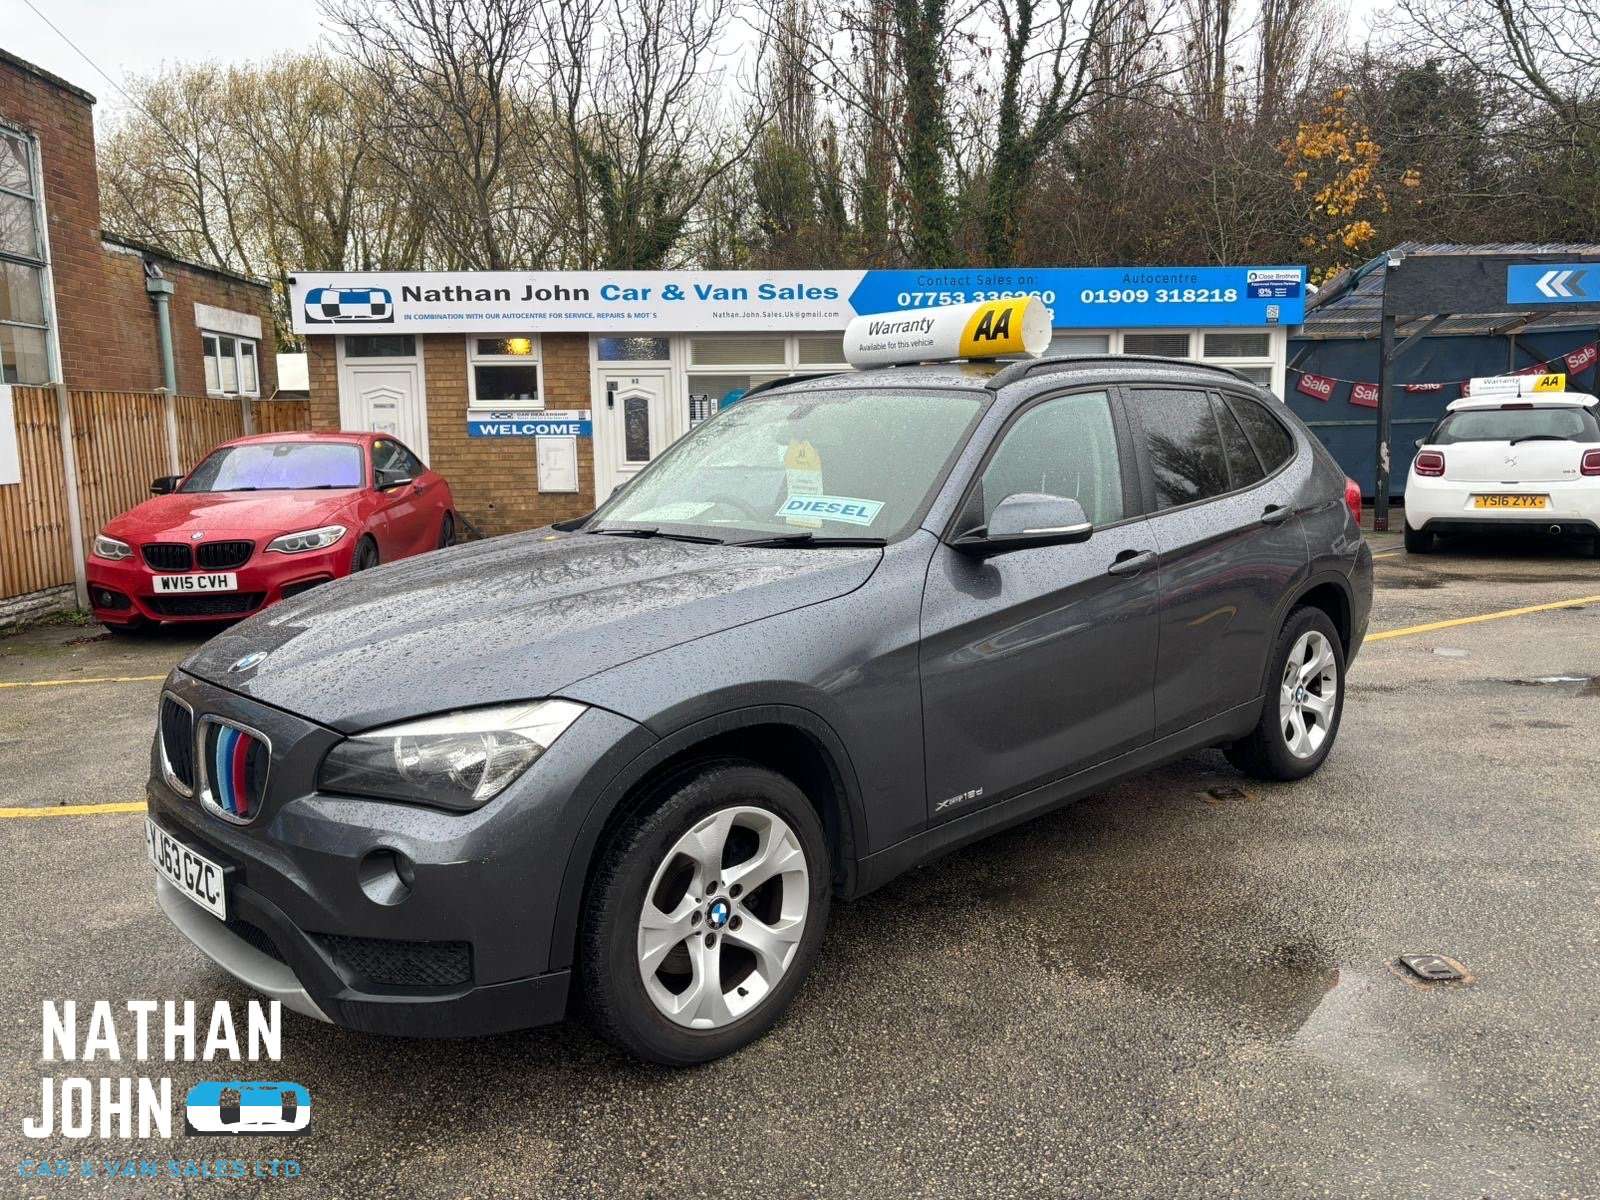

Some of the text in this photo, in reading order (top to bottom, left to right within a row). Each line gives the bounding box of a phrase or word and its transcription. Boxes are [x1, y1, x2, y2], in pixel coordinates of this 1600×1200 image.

[918, 274, 1039, 286] Contact Sales on:
[1123, 272, 1198, 284] Autocentre
[401, 283, 839, 302] Nathan John Car & Van Sales
[897, 291, 965, 306] 07753
[1080, 288, 1238, 303] 01909 318218
[403, 313, 412, 321] IN
[413, 313, 464, 321] COMBINATION
[485, 312, 501, 320] OUR
[502, 312, 547, 320] AUTOCENTRE
[868, 308, 1013, 342] Warranty AA
[859, 339, 934, 352] Available for this vehicle
[1567, 346, 1596, 369] Sale
[1301, 374, 1331, 394] Sale
[1541, 375, 1559, 387] AA
[480, 424, 581, 435] WELCOME
[1482, 495, 1537, 506] YS16 ZYX
[787, 500, 869, 518] DIESEL
[161, 575, 228, 590] WV15 CVH
[150, 823, 217, 905] YJ63 GZC
